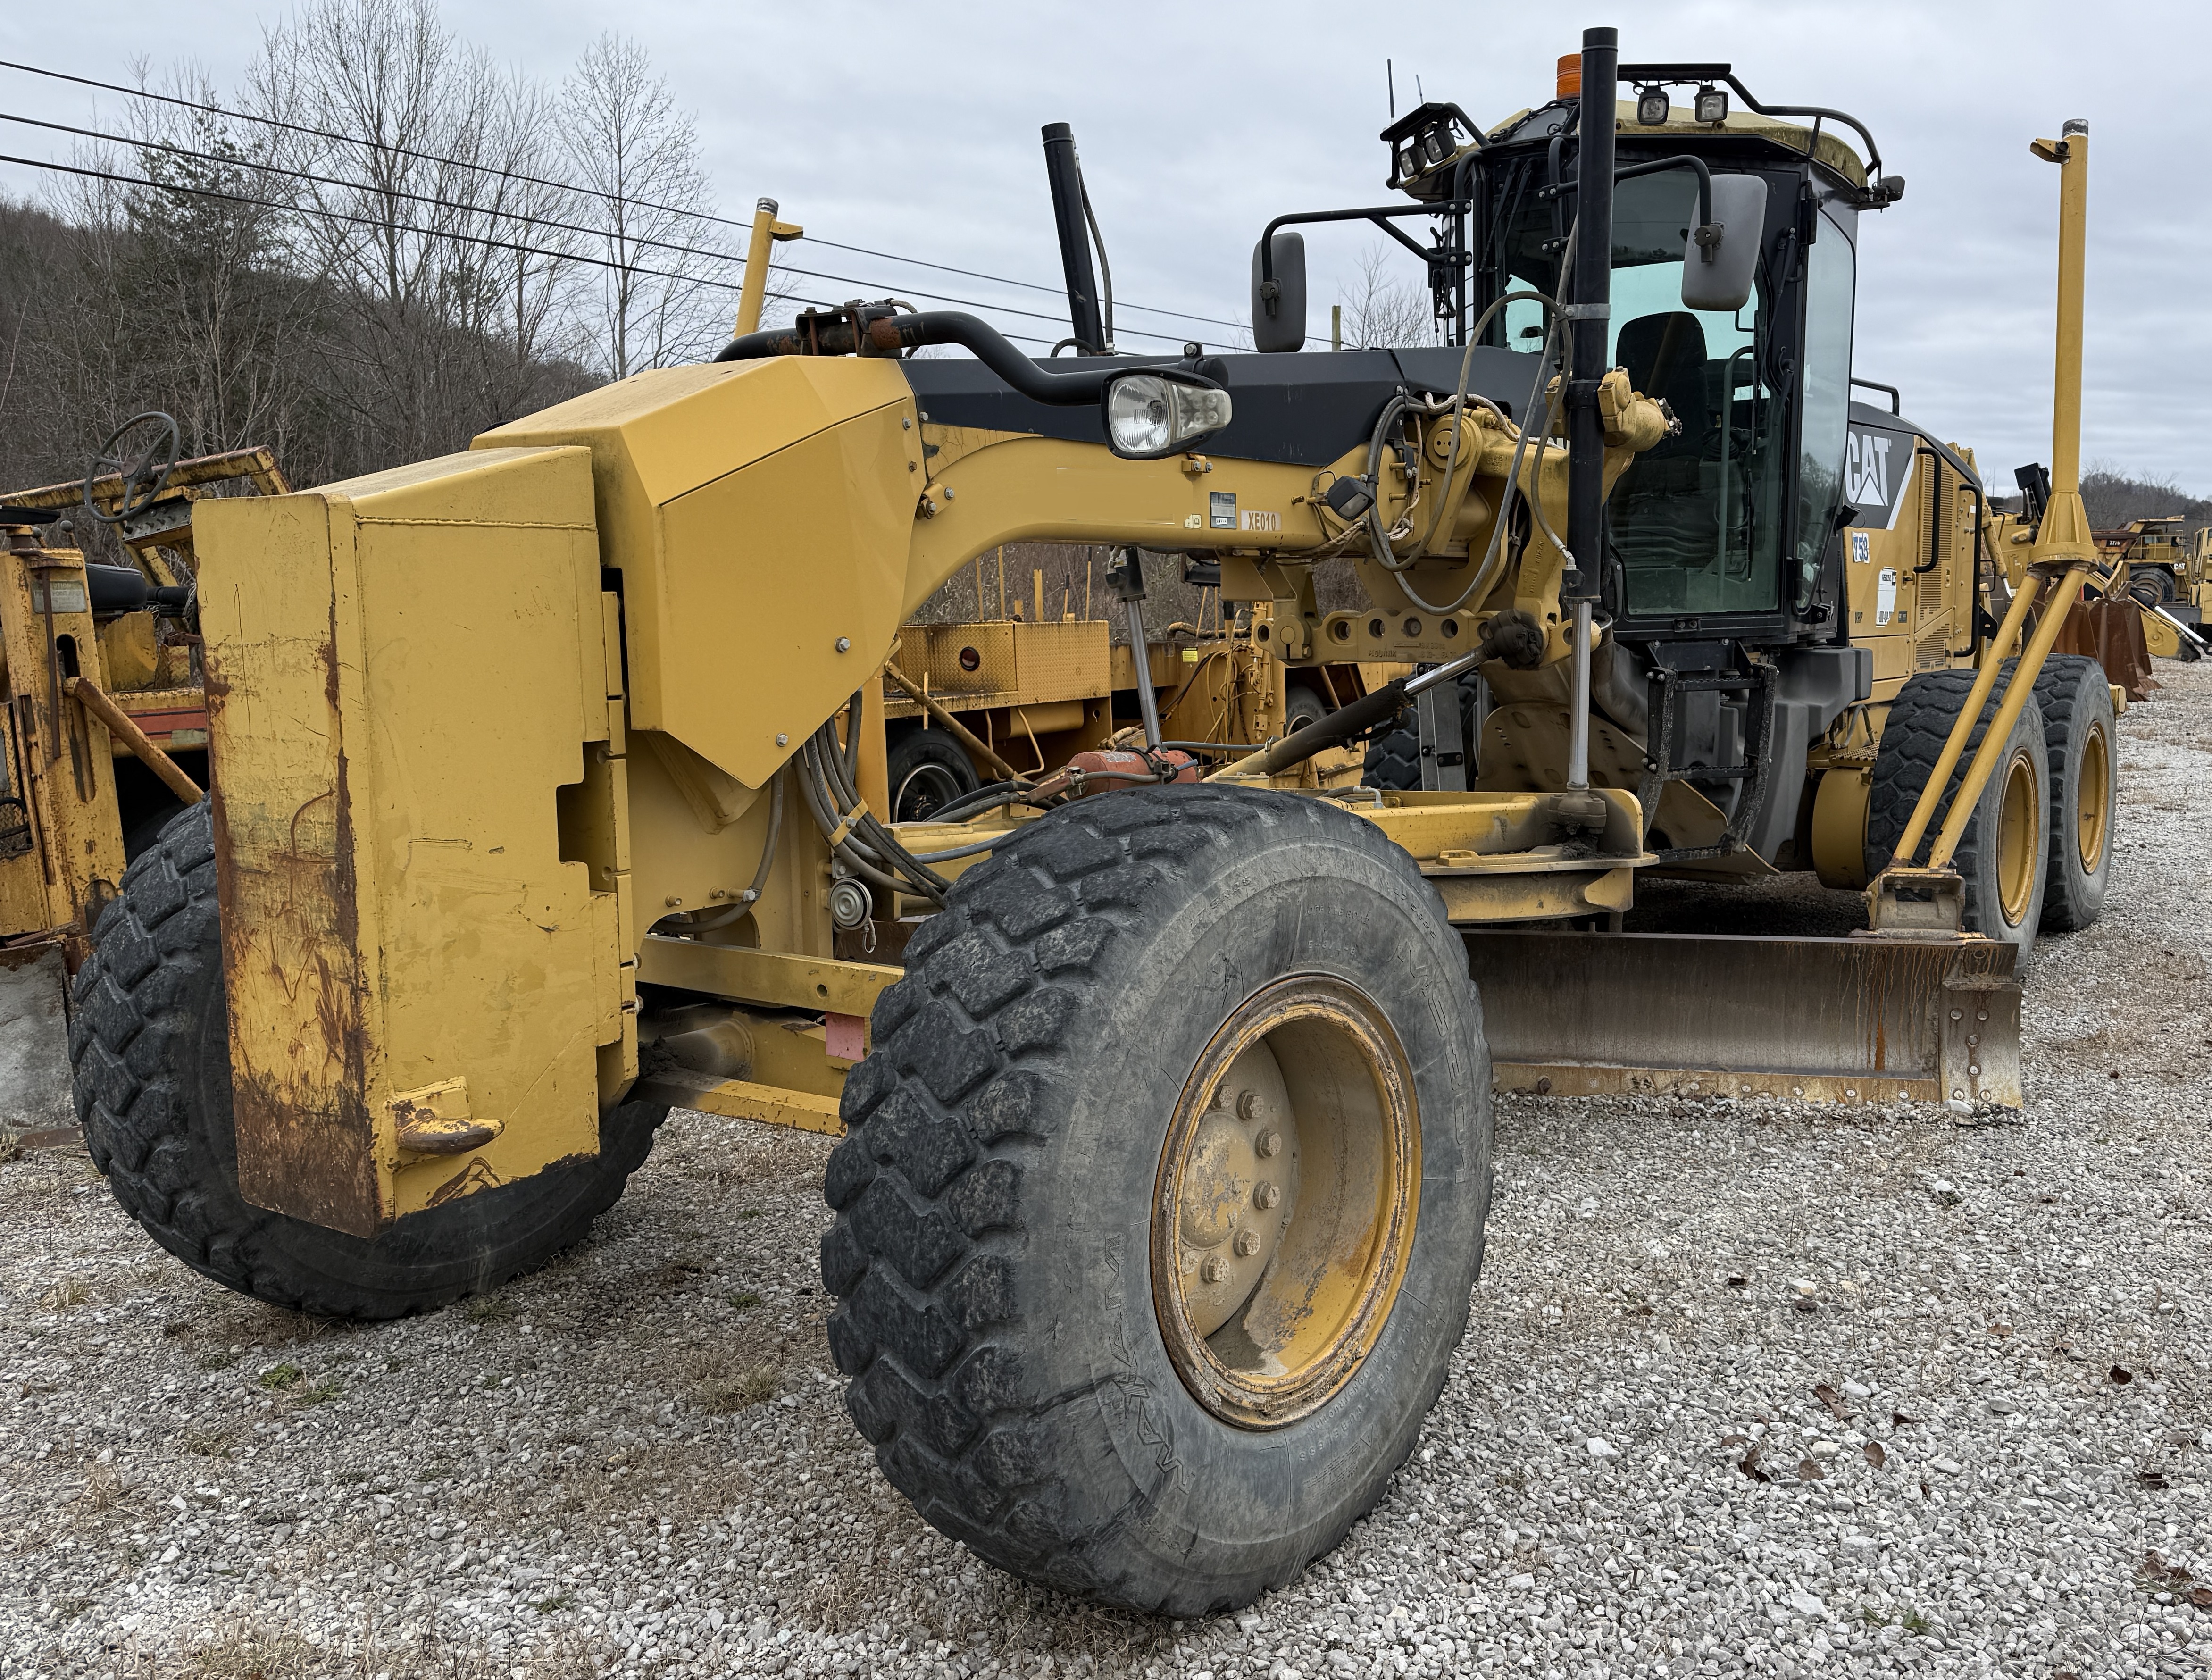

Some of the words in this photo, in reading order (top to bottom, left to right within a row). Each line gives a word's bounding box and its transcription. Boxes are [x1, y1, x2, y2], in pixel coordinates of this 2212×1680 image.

[1845, 431, 1889, 506] CAT
[1249, 512, 1276, 531] XE010
[1105, 1232, 1196, 1495] MAXAM
